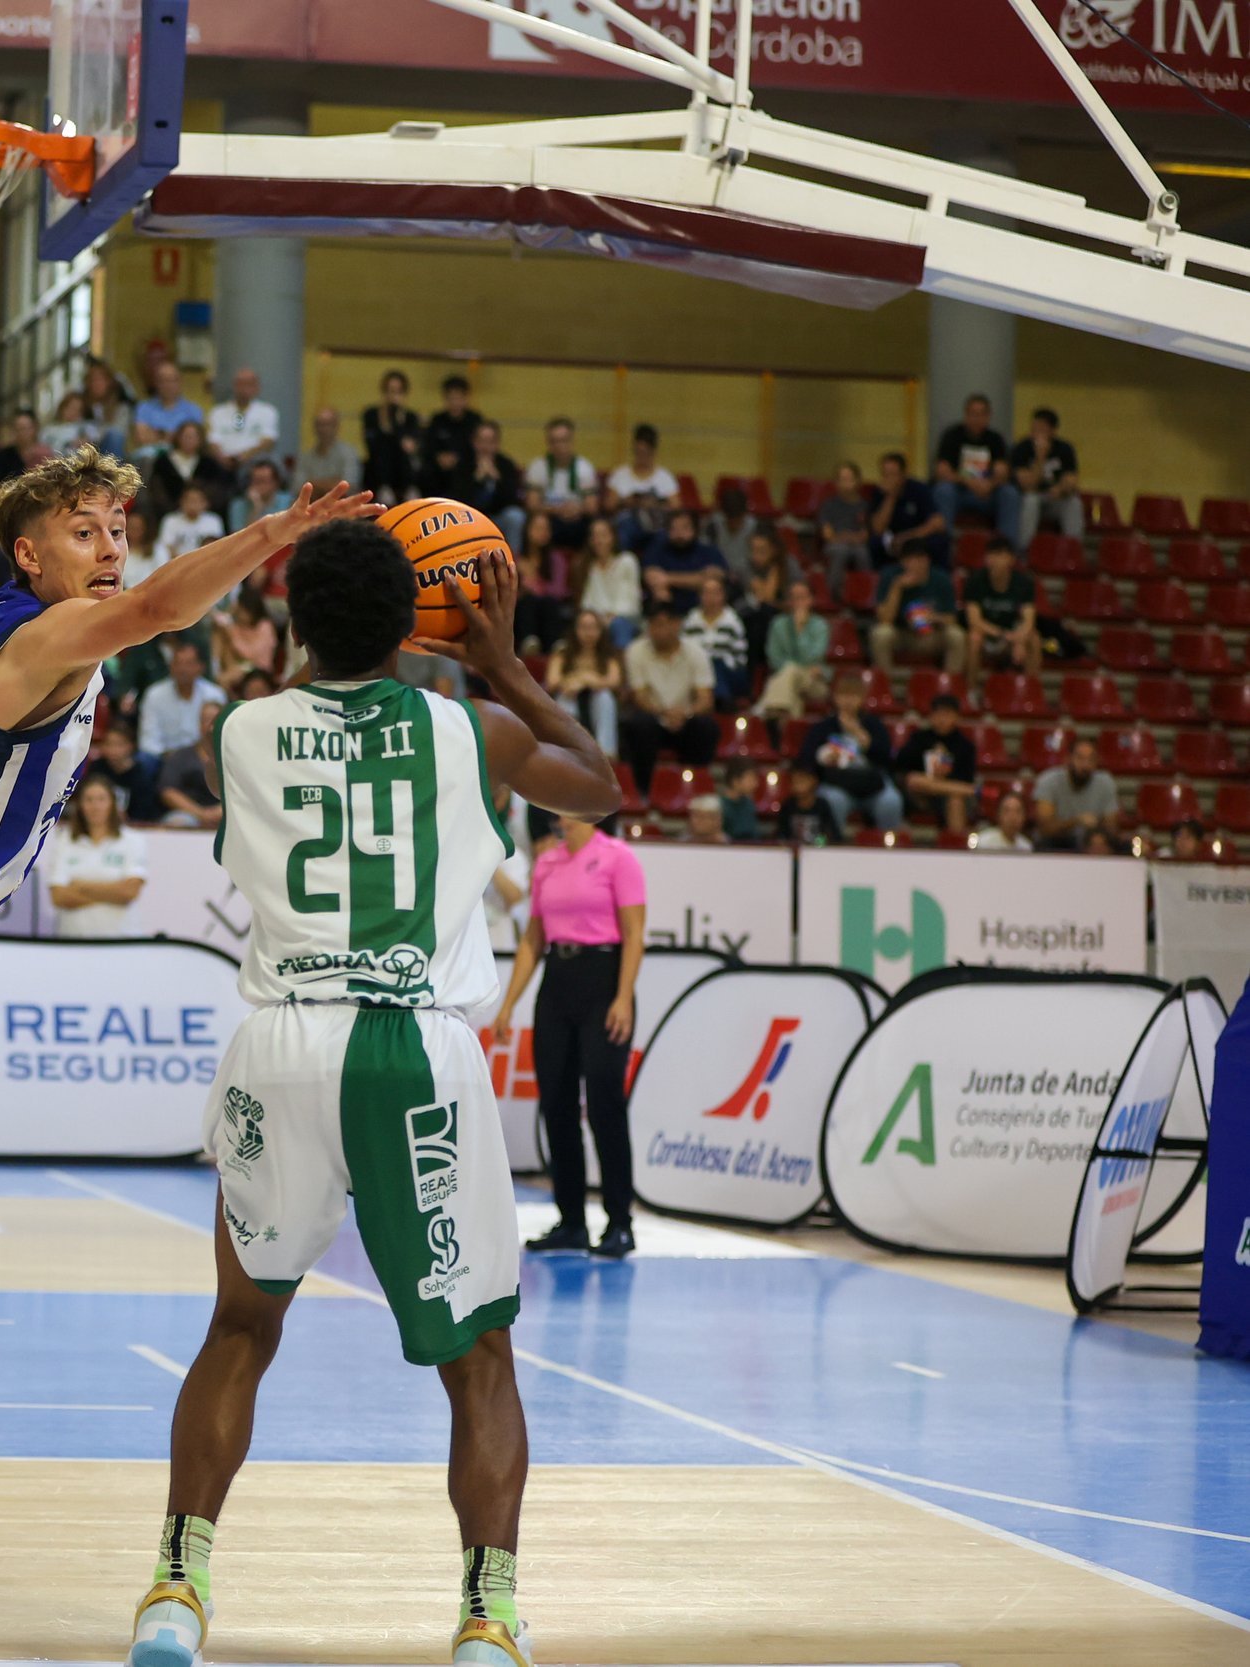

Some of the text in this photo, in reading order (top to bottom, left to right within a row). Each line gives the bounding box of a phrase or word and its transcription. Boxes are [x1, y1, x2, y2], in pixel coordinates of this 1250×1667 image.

[1152, 0, 1250, 59] IM
[420, 510, 475, 538] EVO
[277, 720, 416, 762] NIXON II
[301, 787, 323, 803] CCB
[283, 779, 415, 915] 24
[1187, 883, 1250, 905] INVER
[979, 917, 1105, 954] Hospital
[6, 1003, 218, 1046] REALE
[6, 1051, 218, 1085] SEGUROS
[961, 1068, 1122, 1098] Junta de Anda
[1049, 1105, 1071, 1129] de
[1076, 1107, 1104, 1131] Tur
[647, 1130, 813, 1187] Cordobesa del Acero
[950, 1135, 1009, 1160] Cultura
[1011, 1144, 1025, 1165] y
